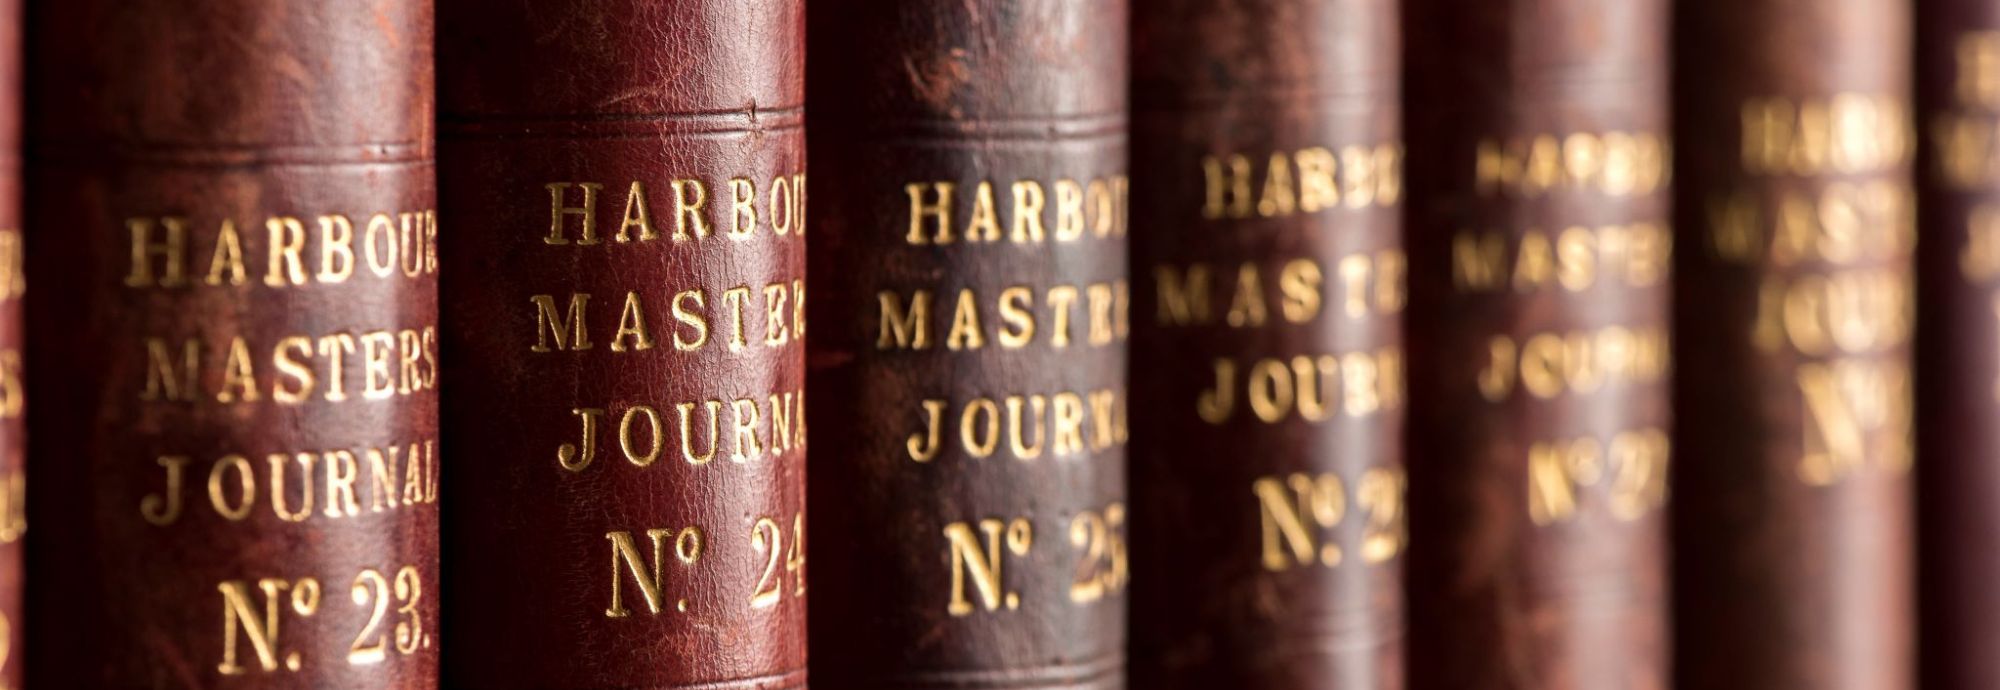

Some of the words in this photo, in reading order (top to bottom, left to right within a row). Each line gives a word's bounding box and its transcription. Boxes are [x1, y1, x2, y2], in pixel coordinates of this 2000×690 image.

[544, 173, 806, 246] HARBOU
[124, 212, 438, 288] HARBOUR
[139, 326, 436, 404] MASTERS
[141, 441, 438, 526] JOURNAL
[749, 511, 806, 608] 24
